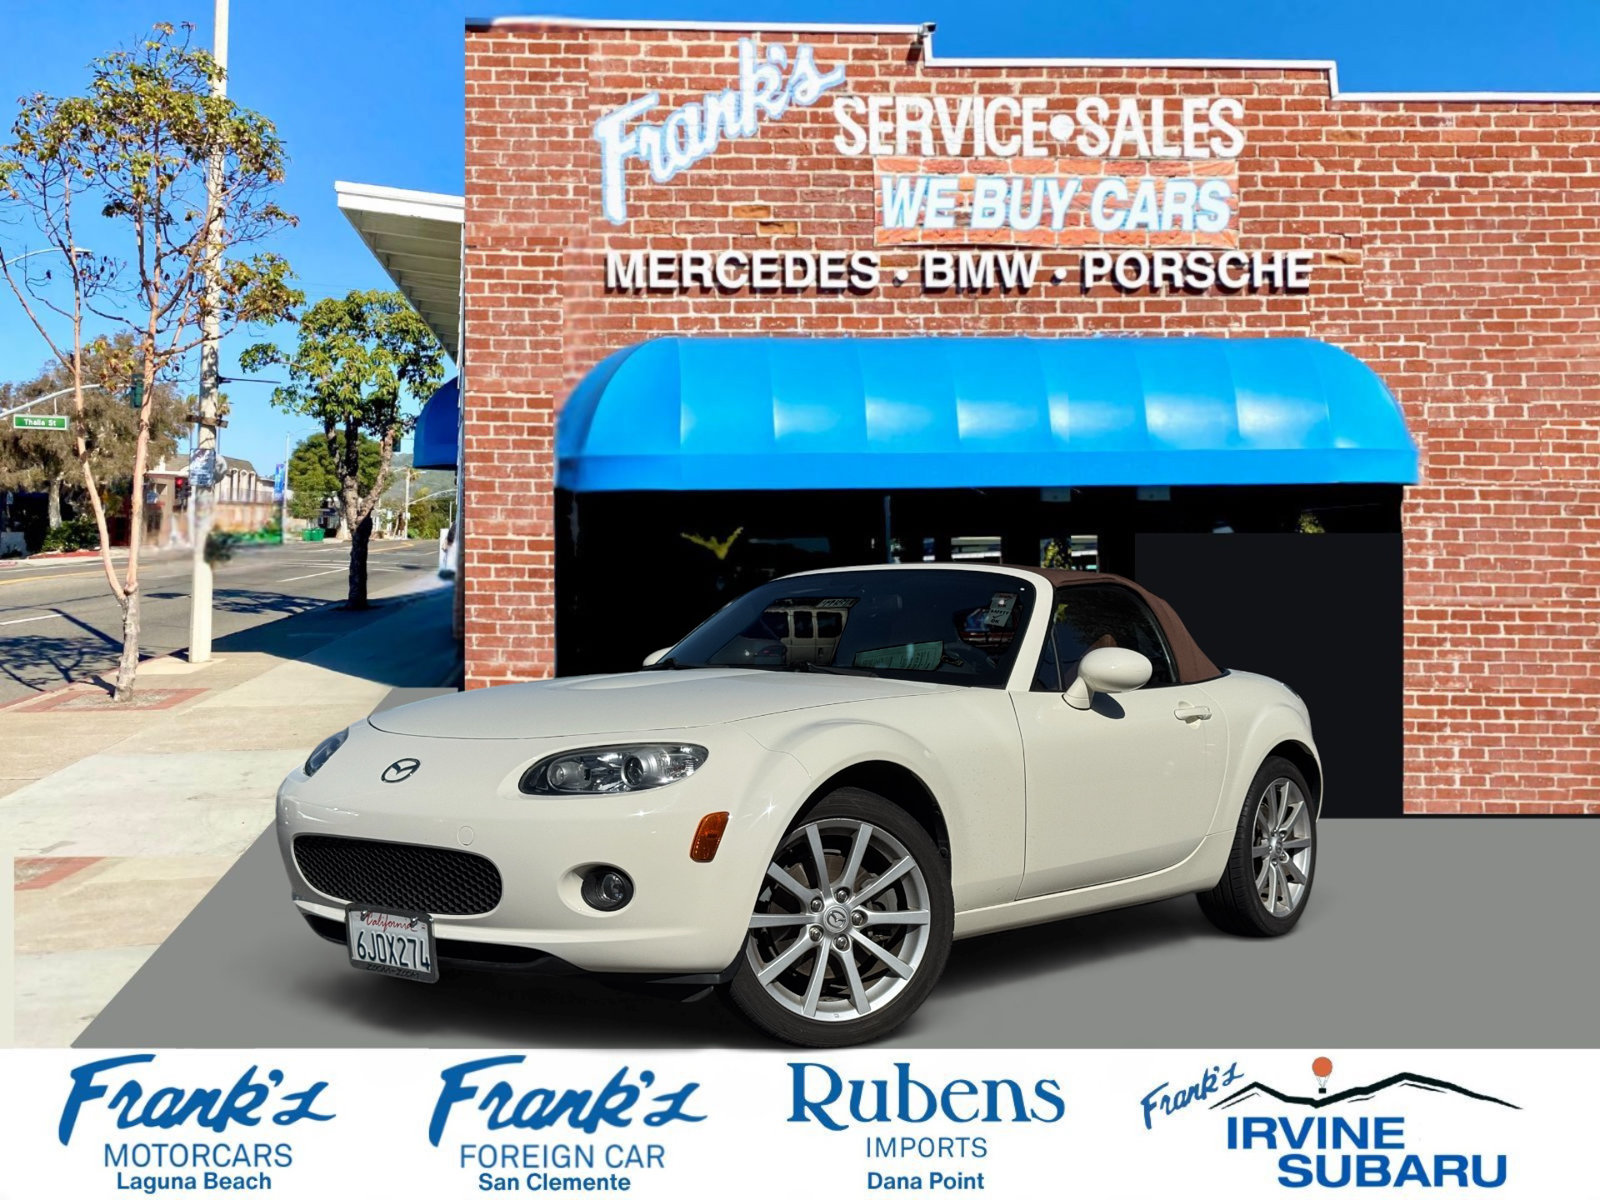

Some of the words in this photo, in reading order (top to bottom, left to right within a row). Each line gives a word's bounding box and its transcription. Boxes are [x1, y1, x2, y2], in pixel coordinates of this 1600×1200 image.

[594, 37, 846, 225] Frank's
[879, 175, 959, 230] WE
[970, 175, 1081, 230] BUY
[1090, 175, 1233, 233] CARS
[606, 250, 880, 290] MERCEDES
[922, 250, 1041, 290] BMW
[1081, 250, 1313, 290] PORSCHE
[23, 418, 46, 426] Thalia
[48, 419, 57, 427] St
[365, 911, 418, 933] California
